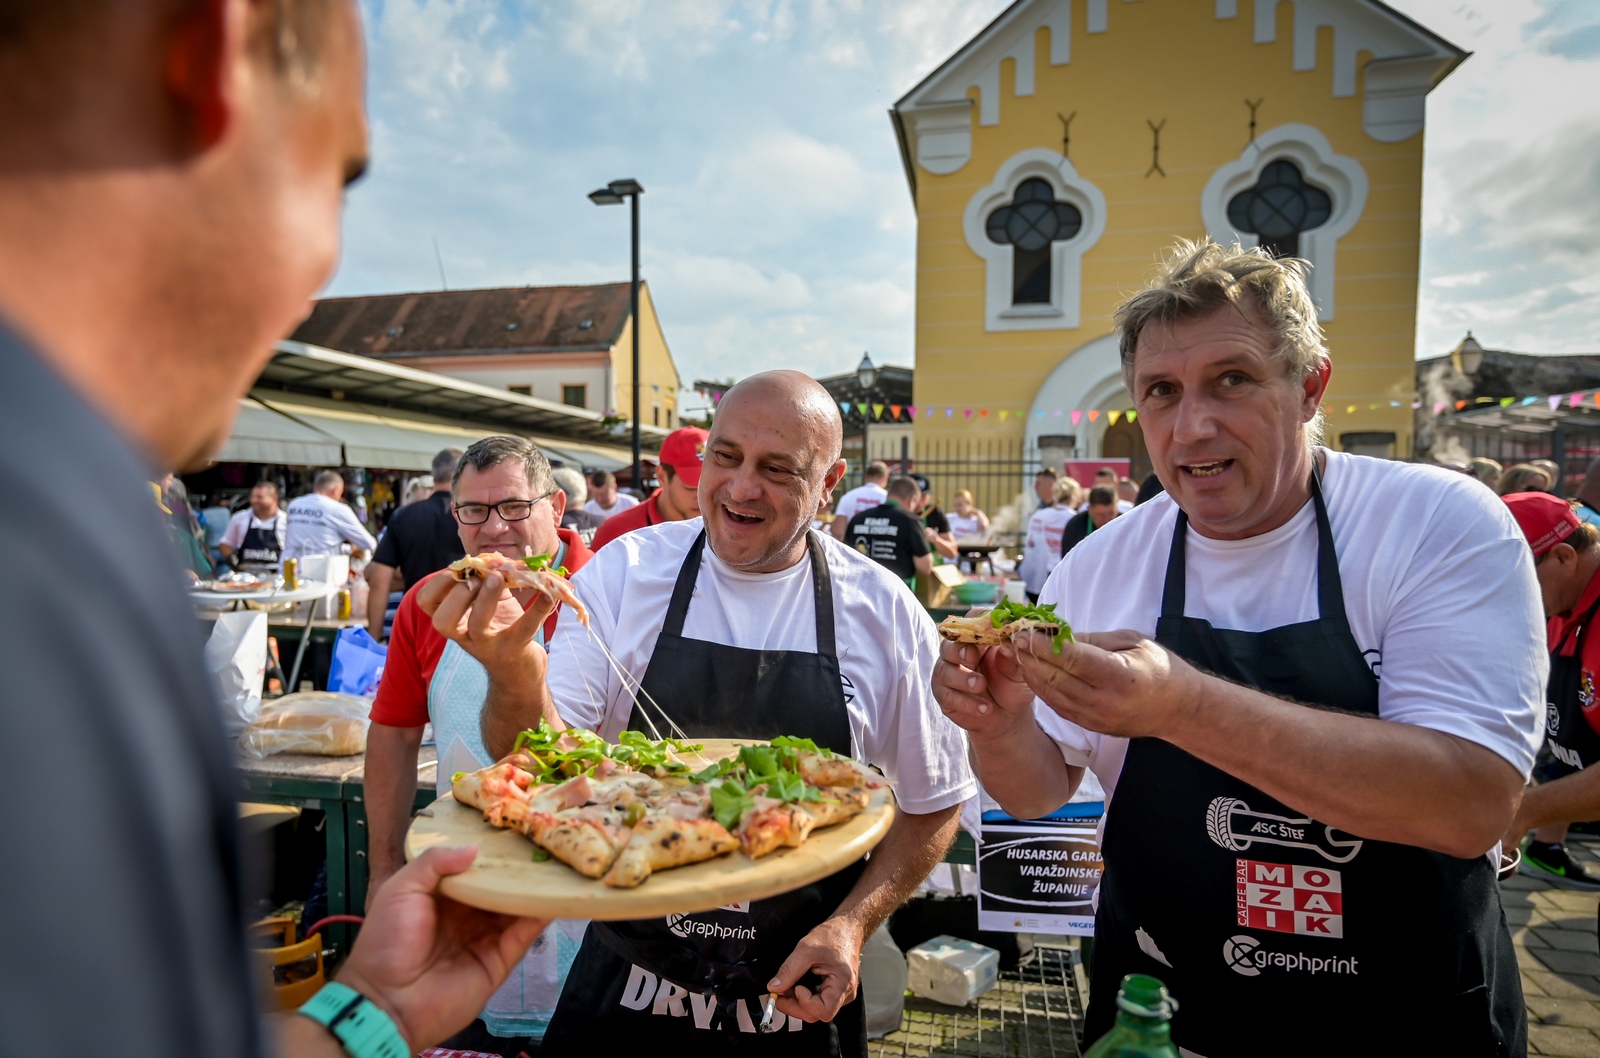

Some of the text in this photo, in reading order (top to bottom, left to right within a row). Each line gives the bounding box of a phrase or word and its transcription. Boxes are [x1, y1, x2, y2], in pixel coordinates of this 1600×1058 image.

[289, 507, 323, 518] MARIO
[1250, 821, 1305, 840] ASC ŠTEF
[1006, 848, 1068, 861] HUSARSKA
[1019, 864, 1101, 879] VARAŽDINSKE
[1031, 880, 1089, 897] ŽUPANIJE
[1236, 859, 1248, 927] CAFFE BAR
[683, 919, 757, 940] graphprint
[1254, 950, 1359, 975] graphprint
